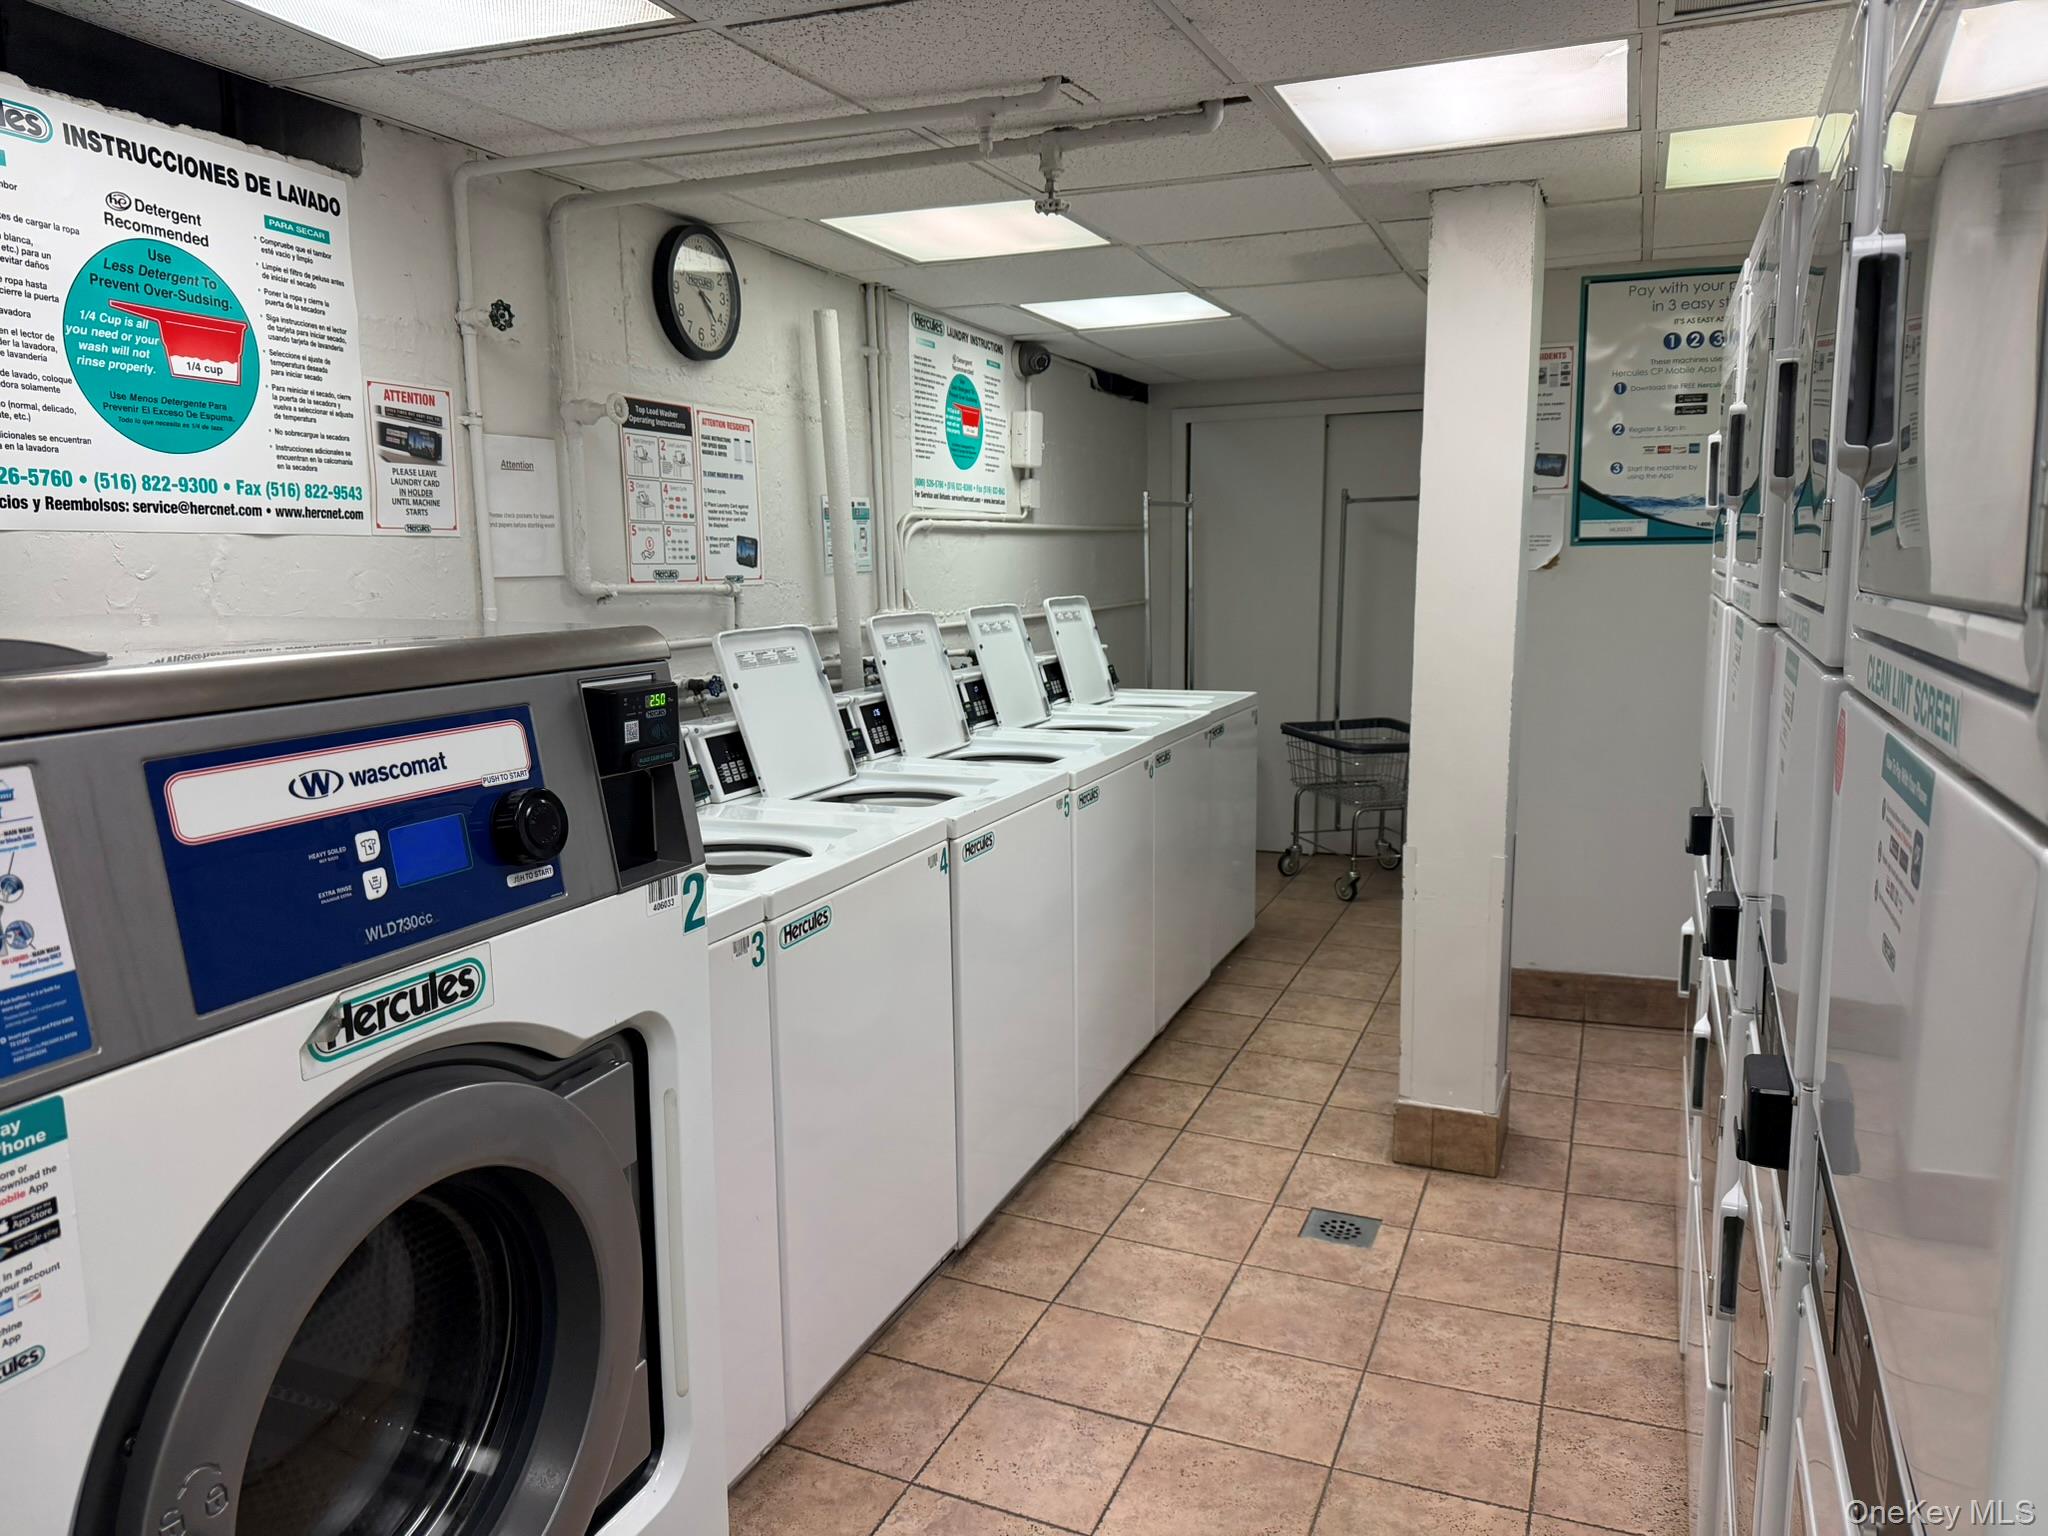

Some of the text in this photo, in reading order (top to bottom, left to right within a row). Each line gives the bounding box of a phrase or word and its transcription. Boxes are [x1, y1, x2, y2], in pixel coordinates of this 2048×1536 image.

[62, 122, 341, 217] INSTRUCCIONES DE LAVADO
[134, 198, 202, 226] Detergent
[26, 218, 80, 236] cargar ropa
[104, 212, 209, 248] Recommended
[268, 218, 325, 240] PARA SECAR
[4, 232, 34, 246] blanca,
[22, 248, 40, 258] para
[148, 248, 172, 264] Use
[24, 258, 50, 270] daños
[104, 258, 217, 290] Less Detergent To
[4, 277, 48, 290] ropa hasta
[1628, 281, 1724, 298] Pay with your
[34, 293, 60, 303] puerta
[90, 273, 232, 311] Prevent Over-Sudsing.
[720, 292, 726, 306] 3
[678, 302, 684, 318] 8
[1652, 299, 1715, 312] in 3 easy
[80, 310, 148, 330] 1/4 Cup is all
[687, 320, 693, 334] 7
[20, 329, 43, 340] lector
[65, 324, 160, 346] you need or your
[698, 328, 705, 342] 6
[710, 324, 716, 338] 5
[914, 311, 1004, 356] Hercules LAUNDRY INSTRUCTIONS
[22, 341, 58, 354] lavadora,
[1669, 332, 1722, 348] 1 2 3
[78, 341, 150, 359] wash will not
[76, 355, 156, 376] rinse properly.
[186, 361, 224, 376] 1/4 cup
[1612, 368, 1648, 378] Hercules
[1665, 366, 1695, 375] Mobile
[1698, 366, 1716, 376] App
[12, 370, 40, 382] lavado,
[42, 374, 72, 387] coloque
[20, 382, 61, 394] solamente
[109, 391, 227, 411] Use Menos Detergente Para
[383, 389, 436, 407] ATTENTION
[8, 400, 76, 415] (normal, delicado,
[103, 402, 236, 423] Prevenir El Exceso De Espuma.
[635, 405, 678, 419] Top Load Washer
[14, 412, 31, 422] etc.)
[628, 416, 686, 430] Operating Instructions
[26, 443, 60, 453] lavadora
[49, 436, 92, 445] encuentran
[626, 436, 632, 447] 1
[660, 440, 666, 451] 2
[392, 467, 438, 478] PLEASE LEAVE
[500, 460, 534, 470] Attention
[94, 472, 136, 494] (516)
[141, 476, 218, 496] 822-9300
[236, 480, 261, 496] Fax
[266, 481, 301, 501] (516)
[304, 483, 363, 501] 822-9543
[390, 478, 440, 488] LAUNDRY CARD
[629, 481, 668, 495] 3 4
[408, 489, 434, 498] HOLDER
[32, 496, 364, 521] y Reembolsos: service@hercnet.com www.hercnet.com
[392, 498, 441, 508] UNTIL MACHINE
[406, 508, 429, 516] STARTS
[631, 525, 672, 537] 5 6
[1866, 654, 1960, 748] CLEAN LINT SCREEN
[300, 752, 448, 797] W wascomat
[482, 770, 528, 784] PUSH TO START
[1078, 788, 1100, 807] Hercules
[1064, 794, 1070, 818] 5
[308, 850, 326, 861] HEAVY
[327, 846, 347, 856] SOILED
[964, 834, 993, 858] Hercules
[940, 847, 949, 875] 4
[525, 868, 552, 880] TO START
[318, 890, 336, 900] EXTRA
[336, 885, 352, 894] RINSE
[653, 898, 675, 912] 406033
[682, 872, 706, 933] 2
[366, 913, 433, 942] WLD730cc
[783, 910, 829, 944] Hercules
[752, 930, 765, 968] 3
[18, 1164, 28, 1174] or
[42, 1164, 58, 1176] the
[28, 1181, 49, 1194] App
[12, 1207, 53, 1230] App Store
[14, 1262, 33, 1276] and
[22, 1262, 61, 1286] account
[2, 1333, 22, 1348] App
